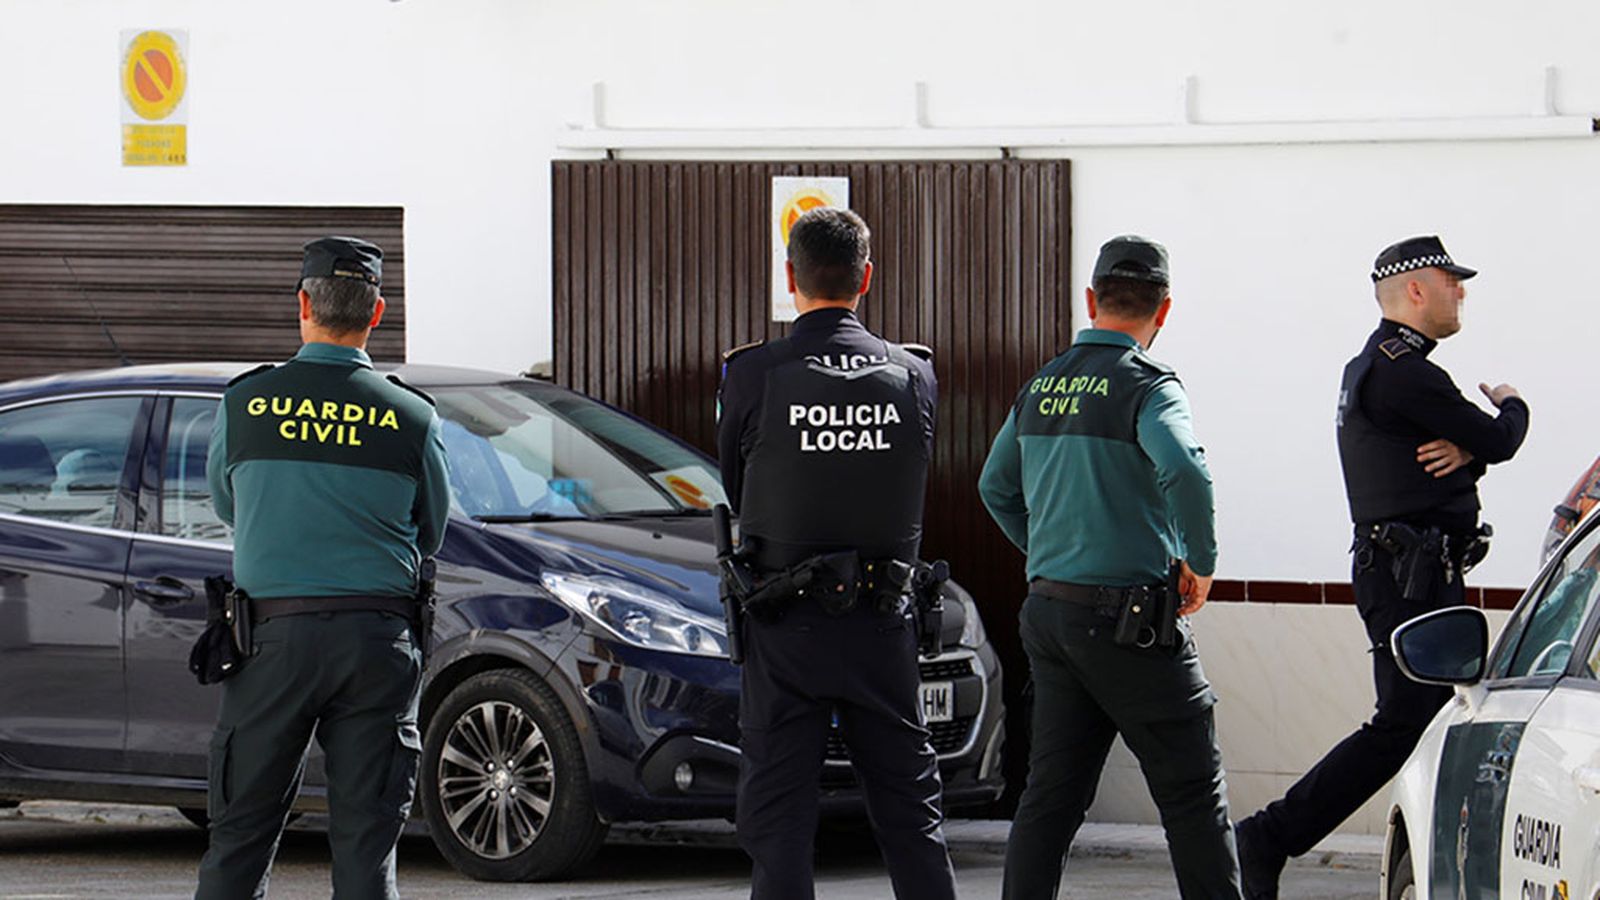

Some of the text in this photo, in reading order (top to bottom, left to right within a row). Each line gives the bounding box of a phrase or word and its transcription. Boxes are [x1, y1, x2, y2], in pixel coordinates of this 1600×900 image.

[1029, 375, 1109, 397] GUARDIA
[247, 397, 399, 430] GUARDIA
[789, 403, 901, 427] POLICIA
[1039, 396, 1080, 415] CIVIL
[279, 419, 362, 446] CIVIL
[800, 429, 891, 451] LOCAL
[924, 687, 947, 717] HM
[1514, 813, 1562, 870] GUARDIA
